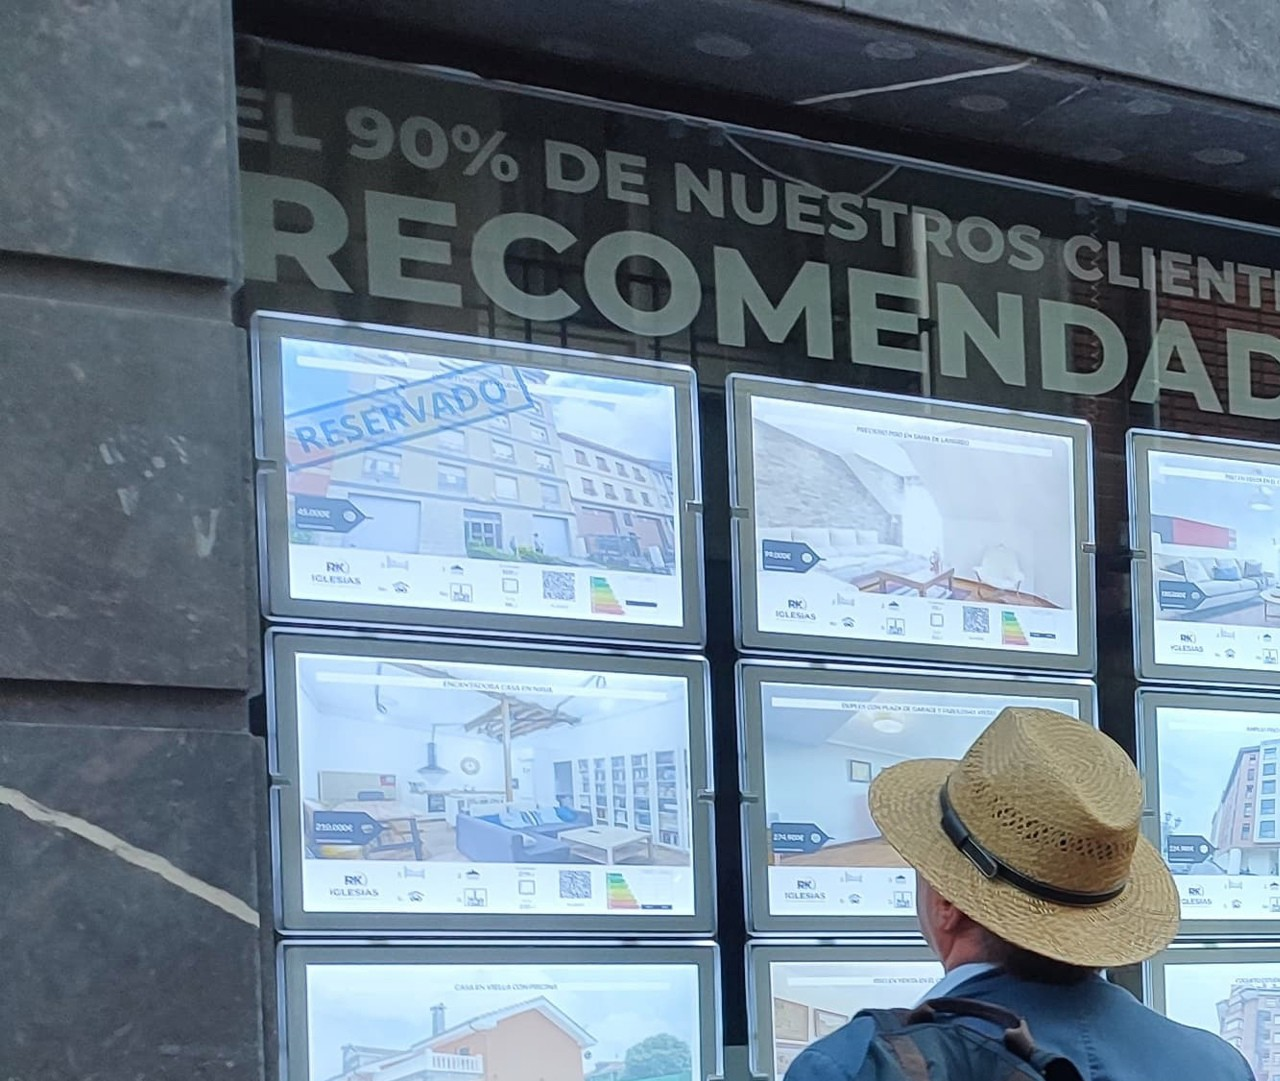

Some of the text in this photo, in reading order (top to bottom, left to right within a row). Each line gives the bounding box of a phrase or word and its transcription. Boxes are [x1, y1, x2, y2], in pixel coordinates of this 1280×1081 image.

[236, 86, 322, 152] EL
[345, 106, 519, 184] 90%
[544, 139, 650, 206] DE
[675, 162, 1044, 273] NUESTROS
[294, 379, 507, 453] RESERVADO
[775, 611, 816, 621] IGLESIAS
[329, 888, 379, 898] IGLESIAS
[784, 891, 826, 901] IGLESIAS
